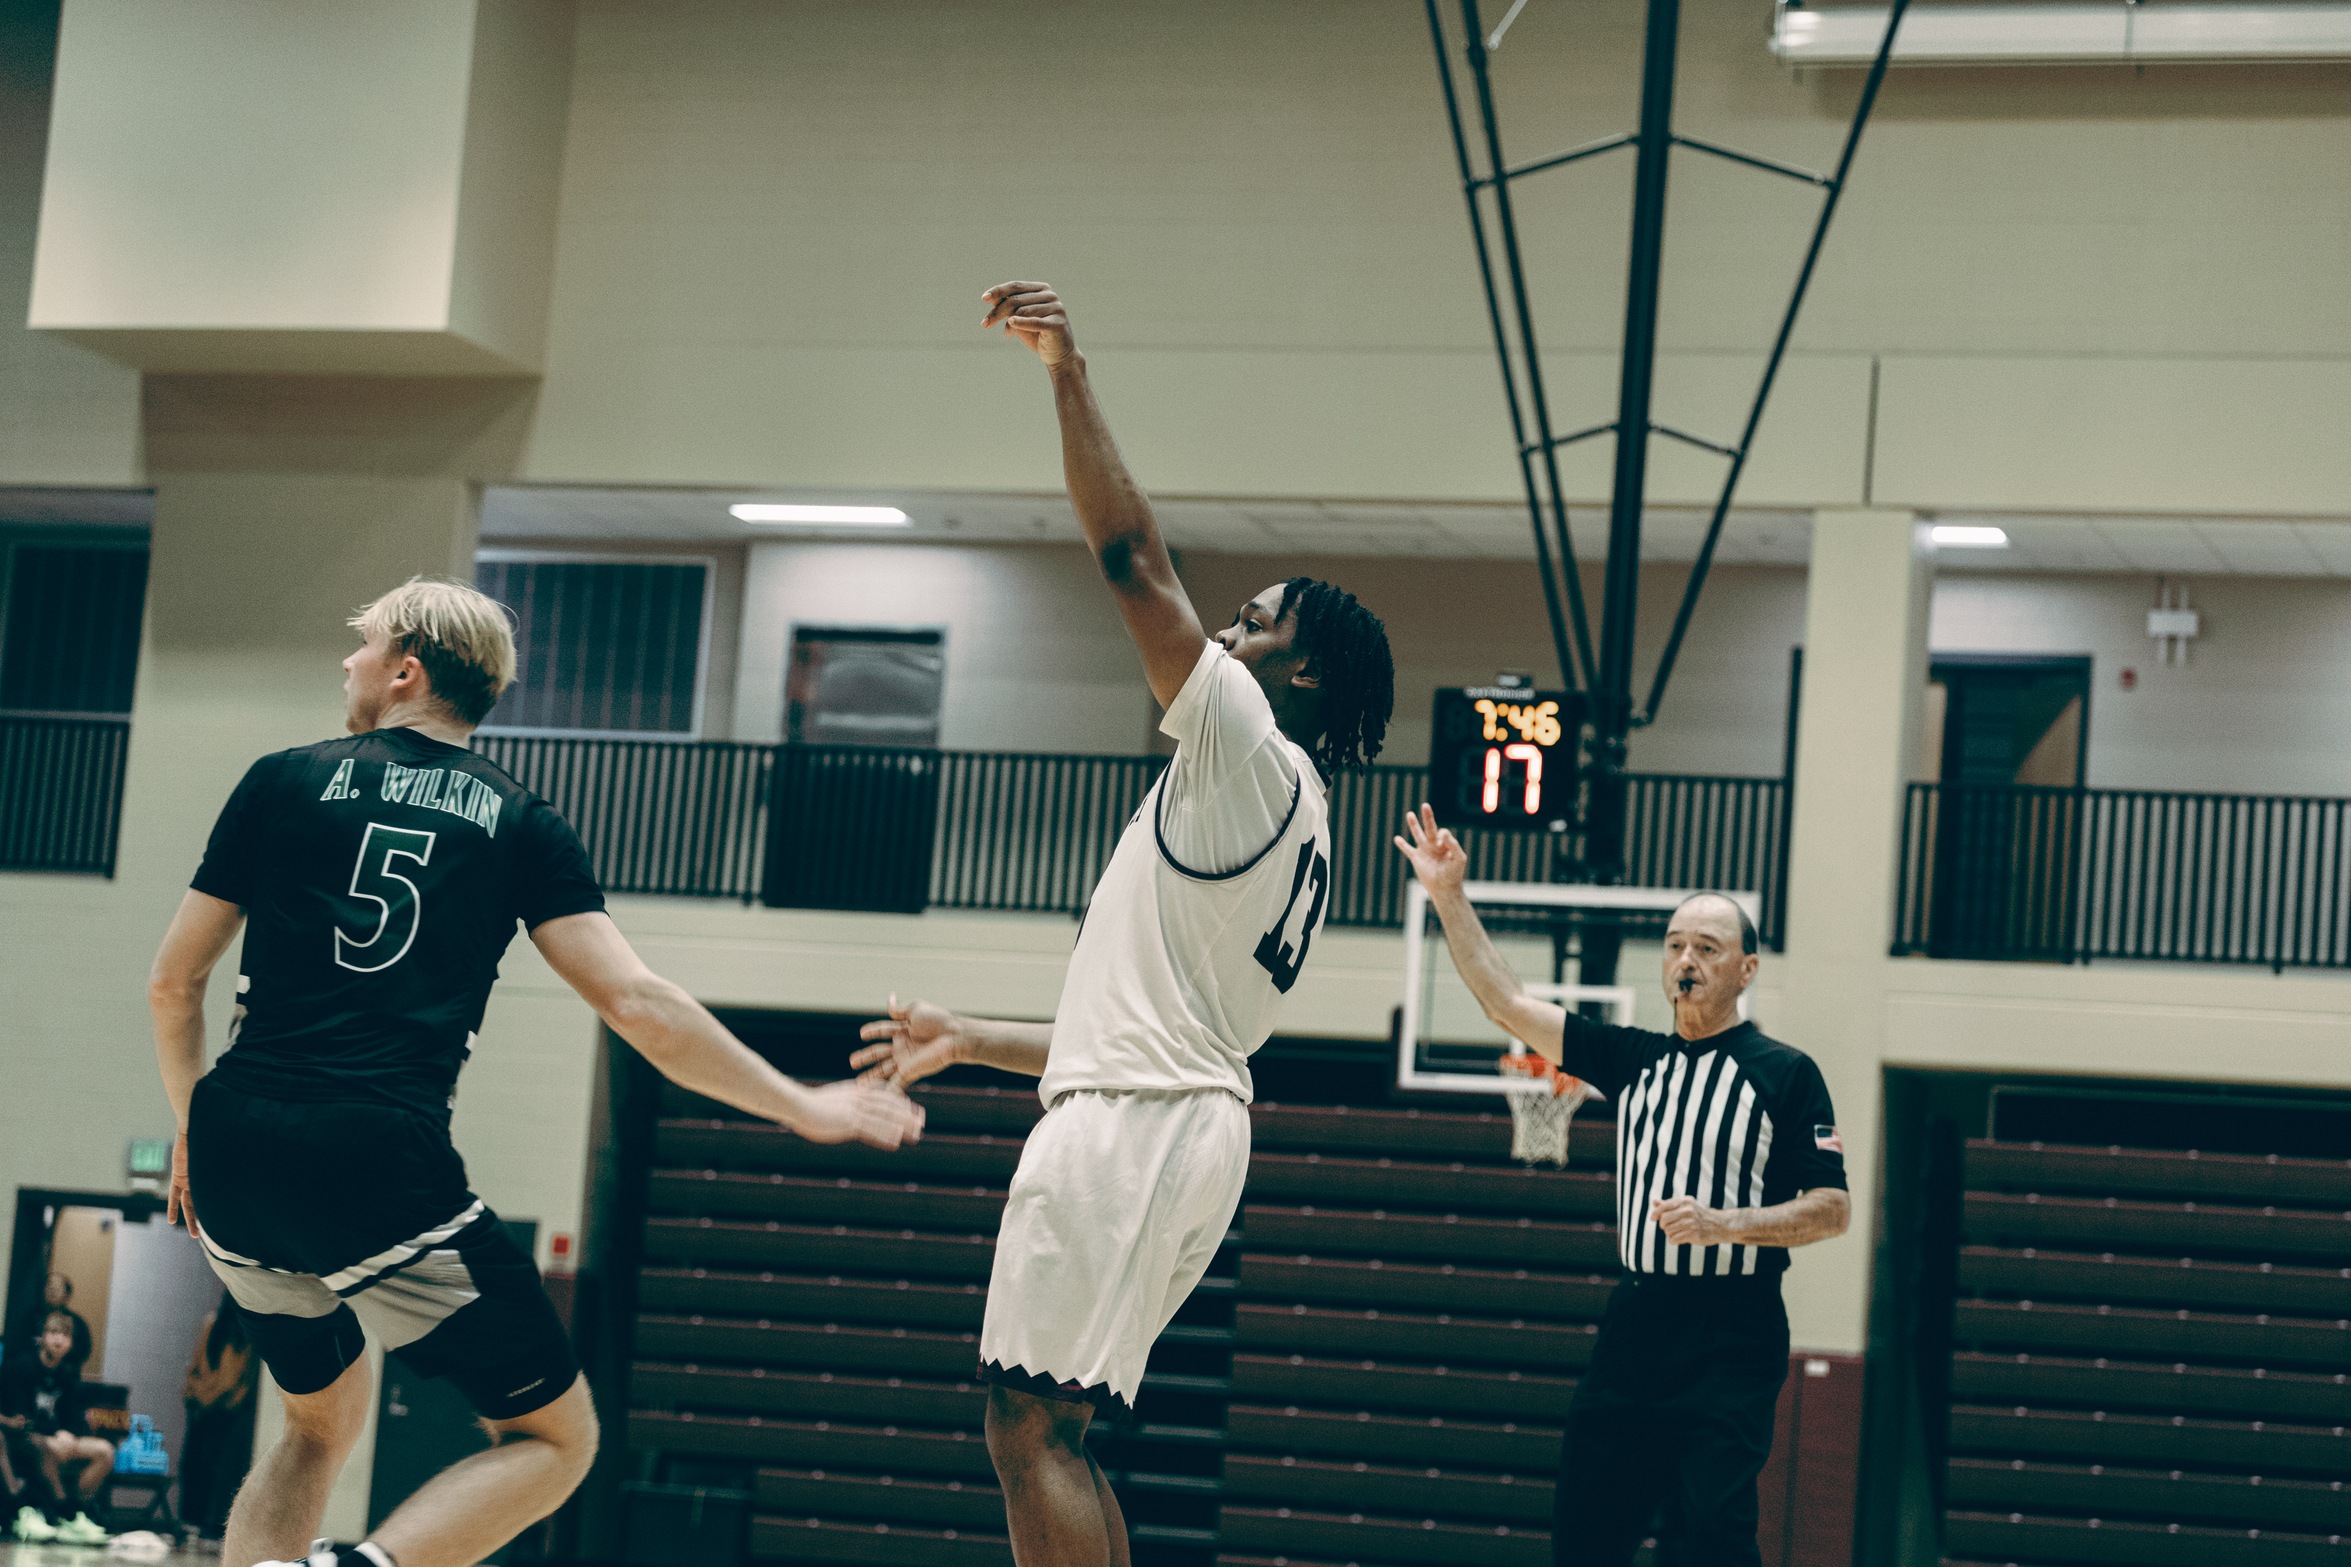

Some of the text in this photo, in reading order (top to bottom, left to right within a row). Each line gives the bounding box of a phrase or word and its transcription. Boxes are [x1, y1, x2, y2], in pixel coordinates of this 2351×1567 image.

[1474, 699, 1562, 746] 7:46
[320, 758, 503, 839] A. WILKIN
[1482, 743, 1543, 815] 17
[334, 822, 437, 973] 5
[1252, 834, 1329, 994] 13
